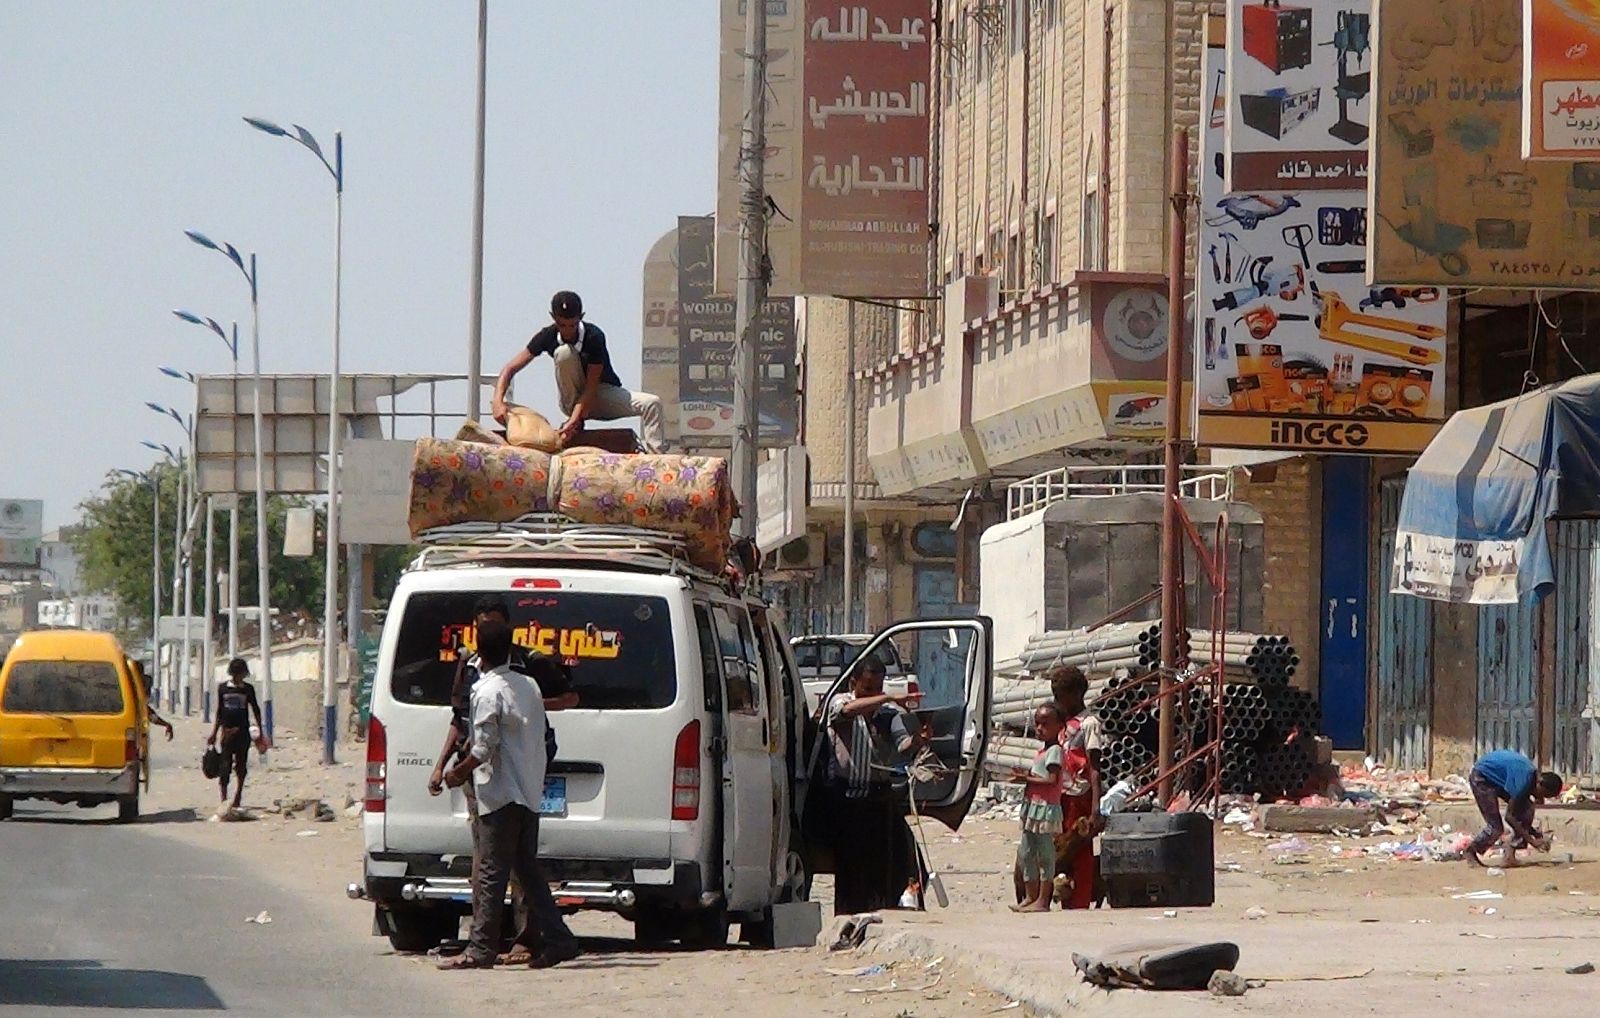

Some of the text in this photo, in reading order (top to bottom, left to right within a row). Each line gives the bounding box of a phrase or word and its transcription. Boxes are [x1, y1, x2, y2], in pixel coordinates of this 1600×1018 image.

[810, 7, 868, 41] الله
[872, 17, 926, 49] عبد
[809, 75, 926, 129] الحبيشي
[808, 154, 925, 197] التجارية
[1277, 160, 1312, 179] قائد
[1315, 158, 1351, 178] أحمد
[682, 303, 733, 315] WORLD
[689, 327, 785, 343] Pananic
